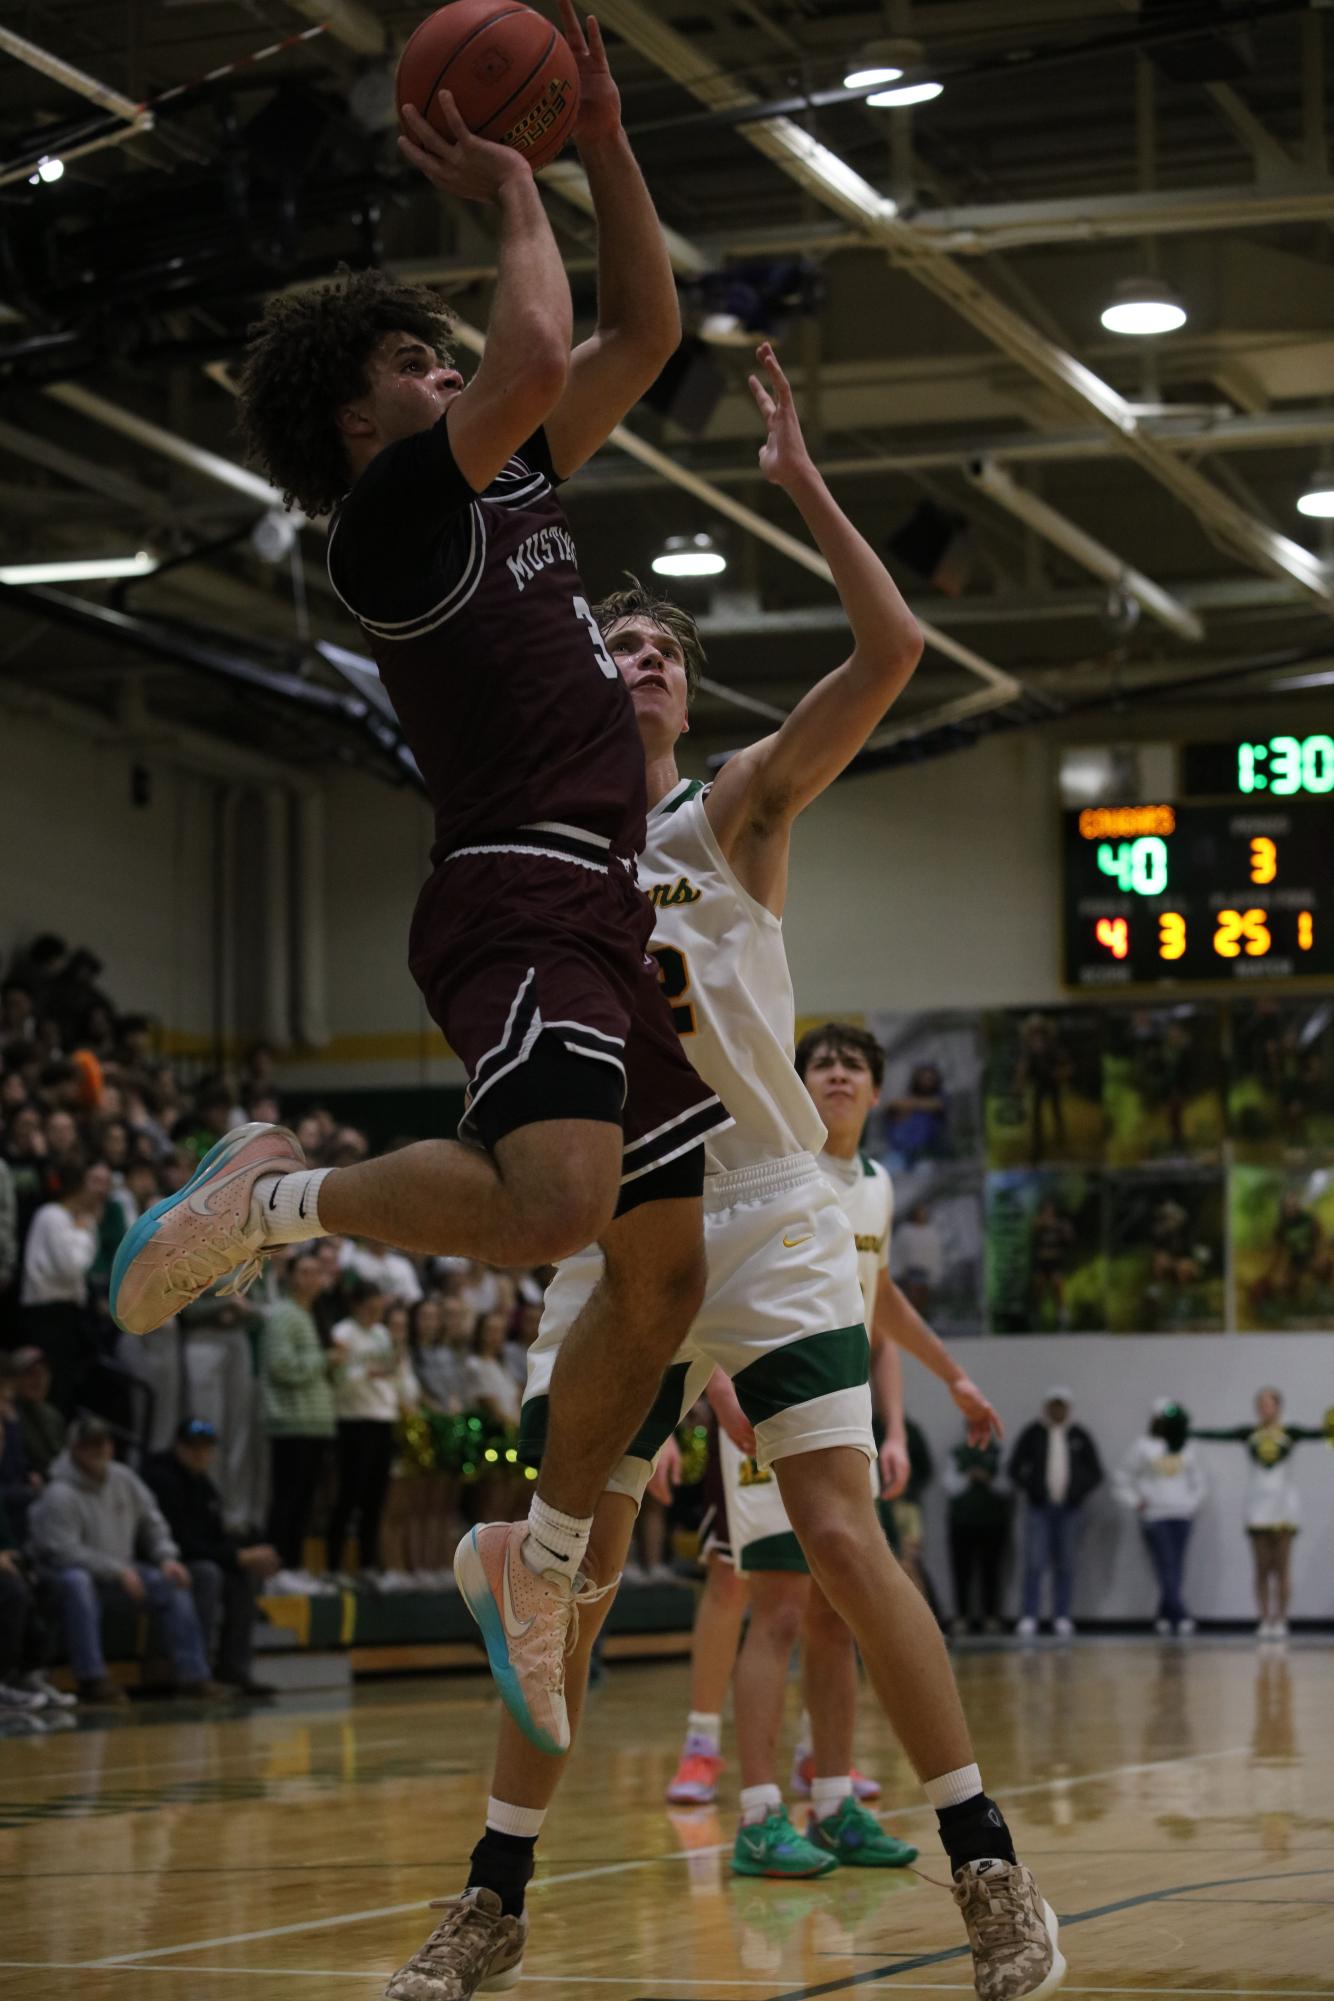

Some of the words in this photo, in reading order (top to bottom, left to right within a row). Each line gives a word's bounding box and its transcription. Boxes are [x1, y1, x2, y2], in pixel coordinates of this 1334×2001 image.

[507, 79, 572, 153] LEGAC
[1237, 734, 1334, 796] 1:30
[1096, 836, 1167, 896] 40
[1249, 835, 1278, 885] 3
[1094, 916, 1129, 960] 4
[1157, 911, 1187, 961] 3
[1212, 907, 1272, 959] 25
[1296, 909, 1314, 952] 1
